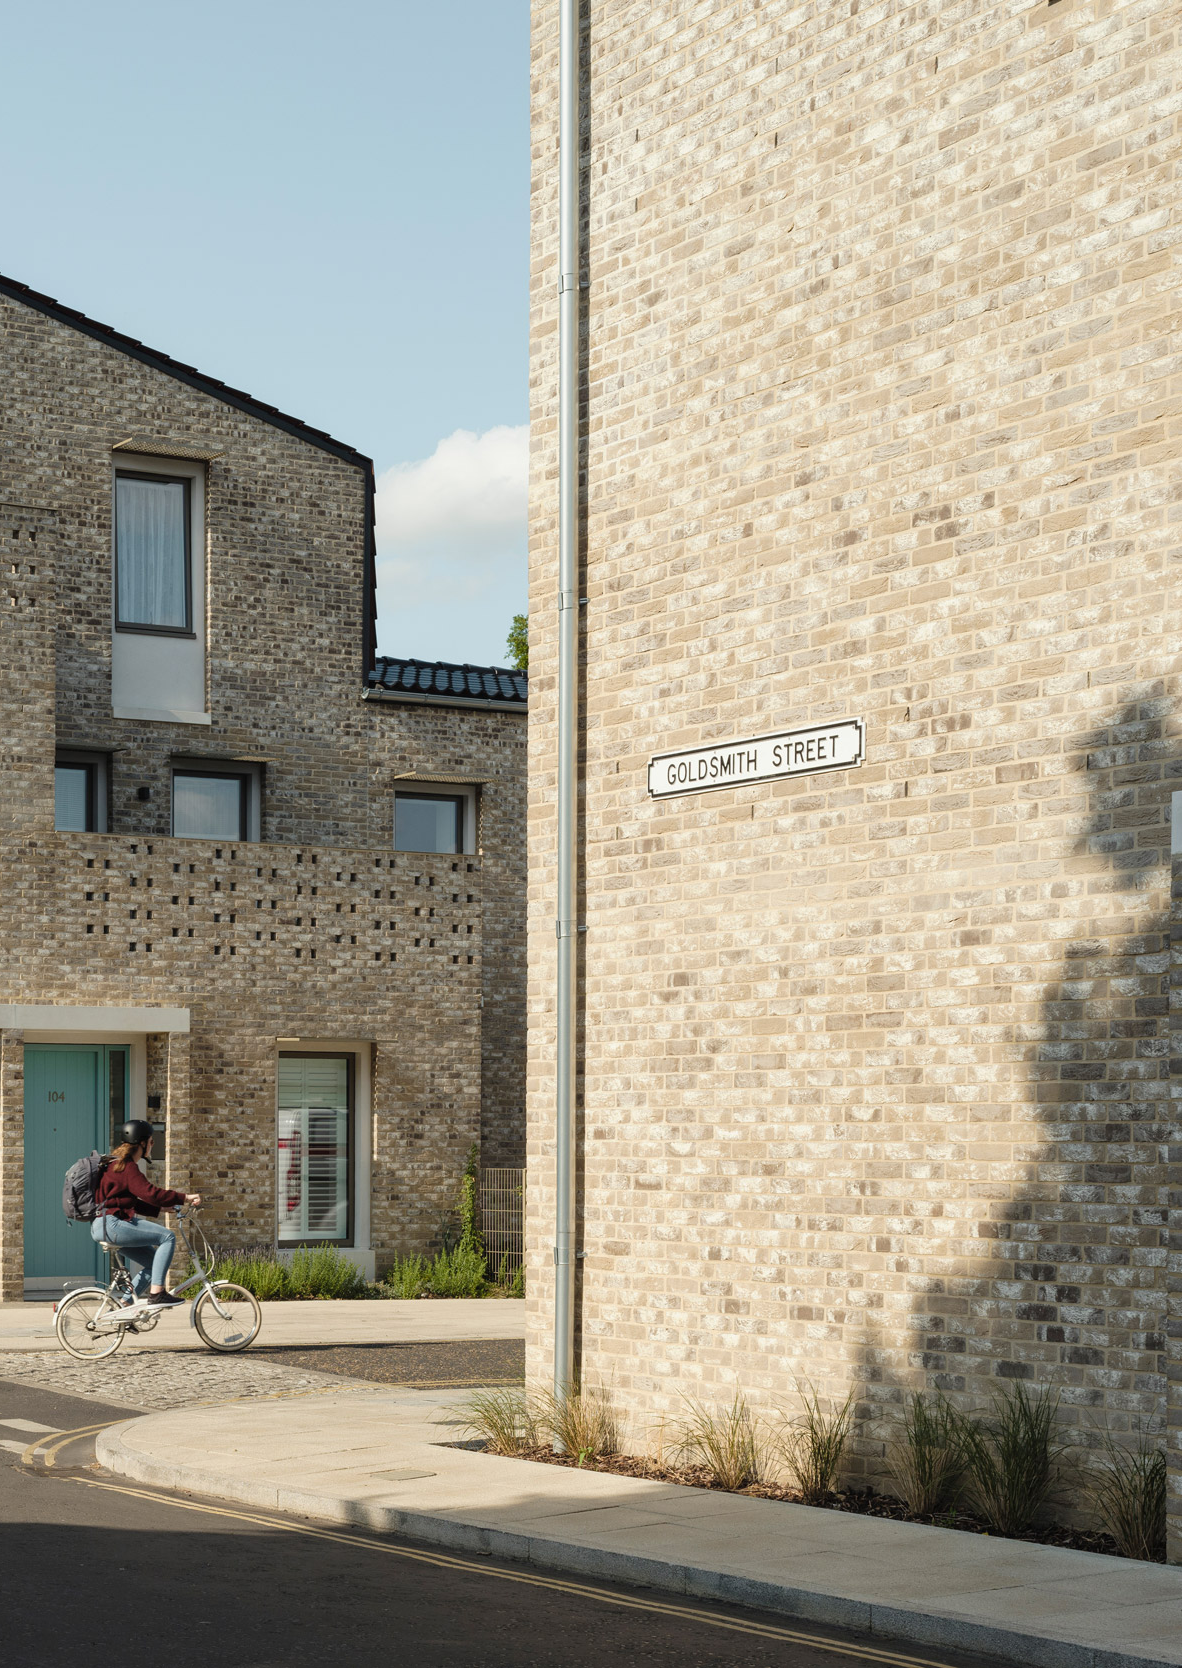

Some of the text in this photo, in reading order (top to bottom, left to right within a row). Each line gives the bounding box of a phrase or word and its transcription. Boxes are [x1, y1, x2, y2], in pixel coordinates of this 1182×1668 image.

[667, 734, 839, 785] GOLDSMITH STREET
[48, 1090, 66, 1103] 104
